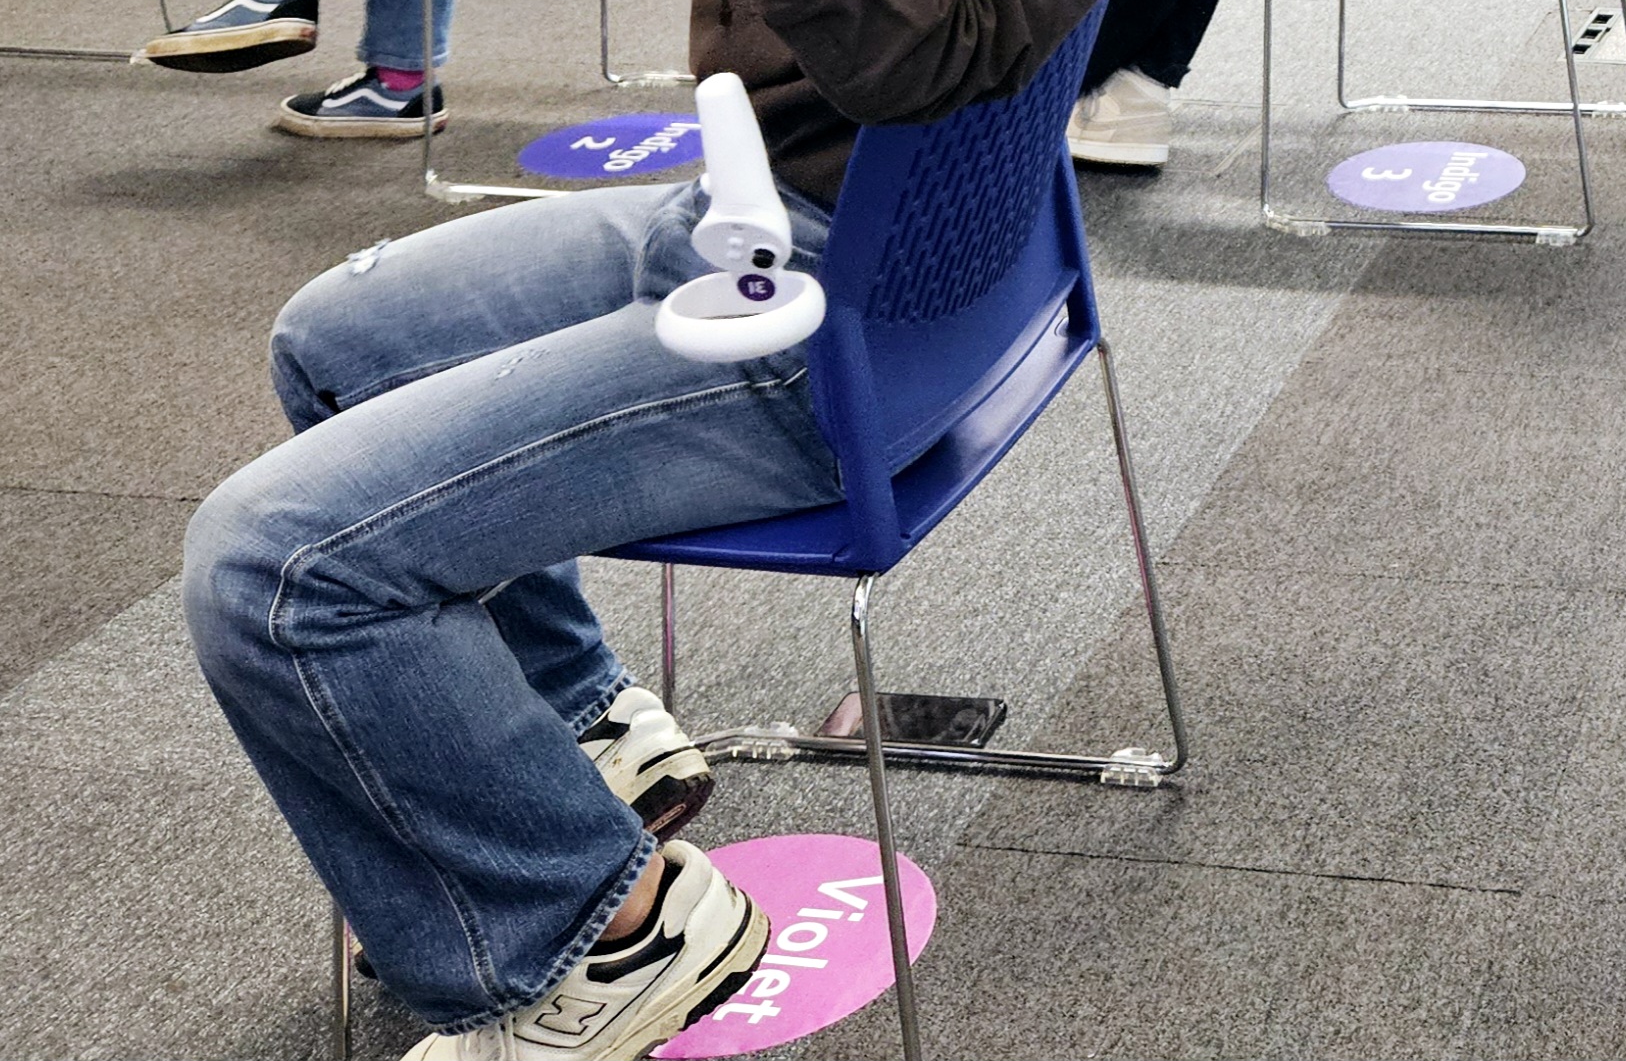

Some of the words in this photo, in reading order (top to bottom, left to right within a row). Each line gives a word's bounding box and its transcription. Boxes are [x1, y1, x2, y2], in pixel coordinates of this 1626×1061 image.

[570, 135, 617, 151] 2
[602, 122, 703, 173] Indigo
[1360, 166, 1413, 182] 3
[1421, 151, 1489, 204] Indigo
[713, 874, 886, 1025] Violet
